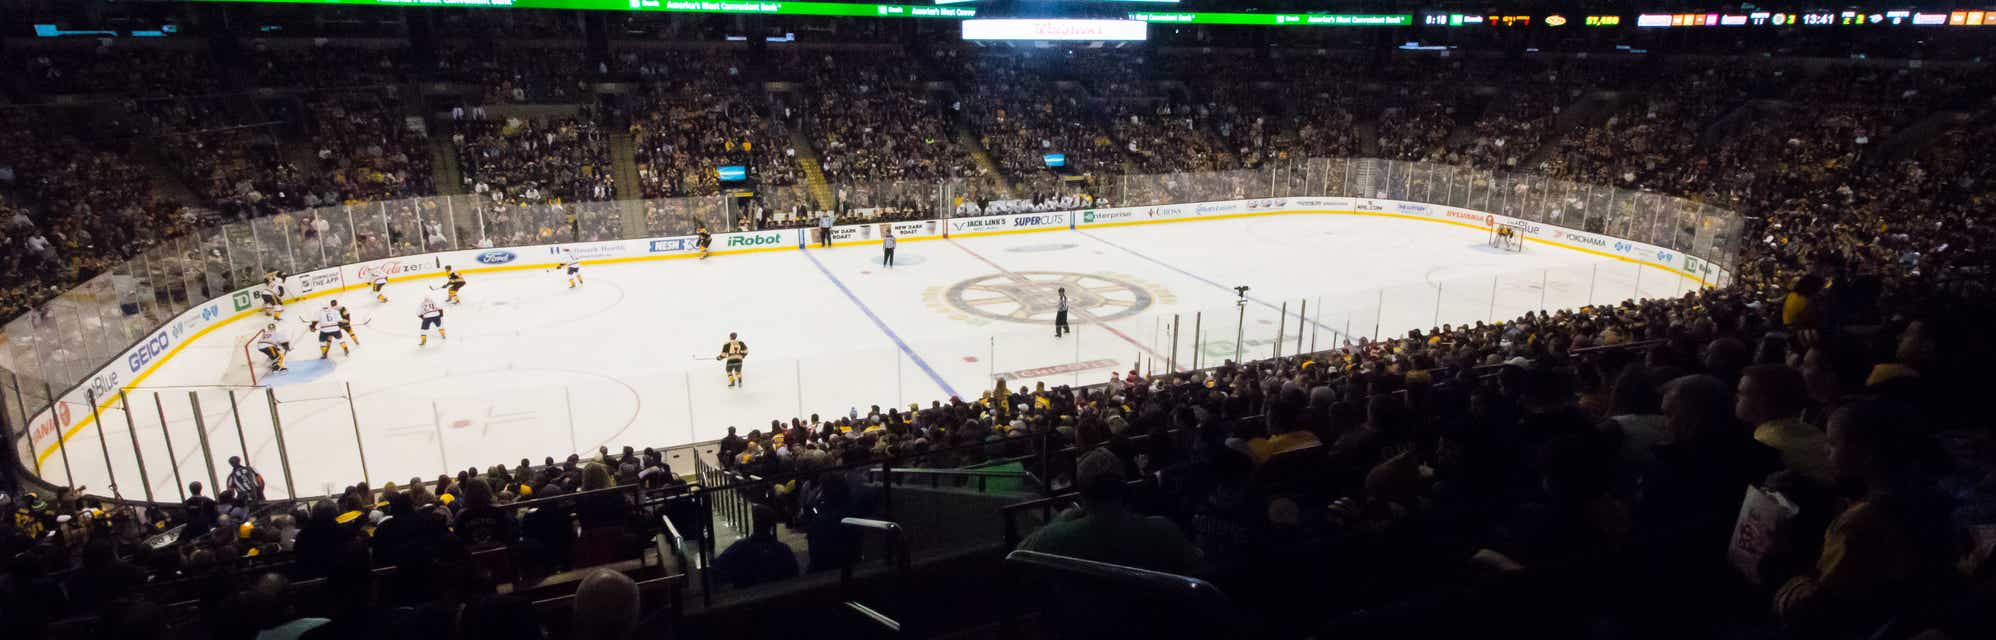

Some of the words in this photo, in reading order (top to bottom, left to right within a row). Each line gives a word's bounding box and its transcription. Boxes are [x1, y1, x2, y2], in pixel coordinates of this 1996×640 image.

[1803, 14, 1834, 24] 13:41
[728, 233, 781, 247] iRobot
[1566, 233, 1606, 248] YOKOHAMA
[483, 251, 511, 263] Ford
[128, 331, 169, 373] GEICO
